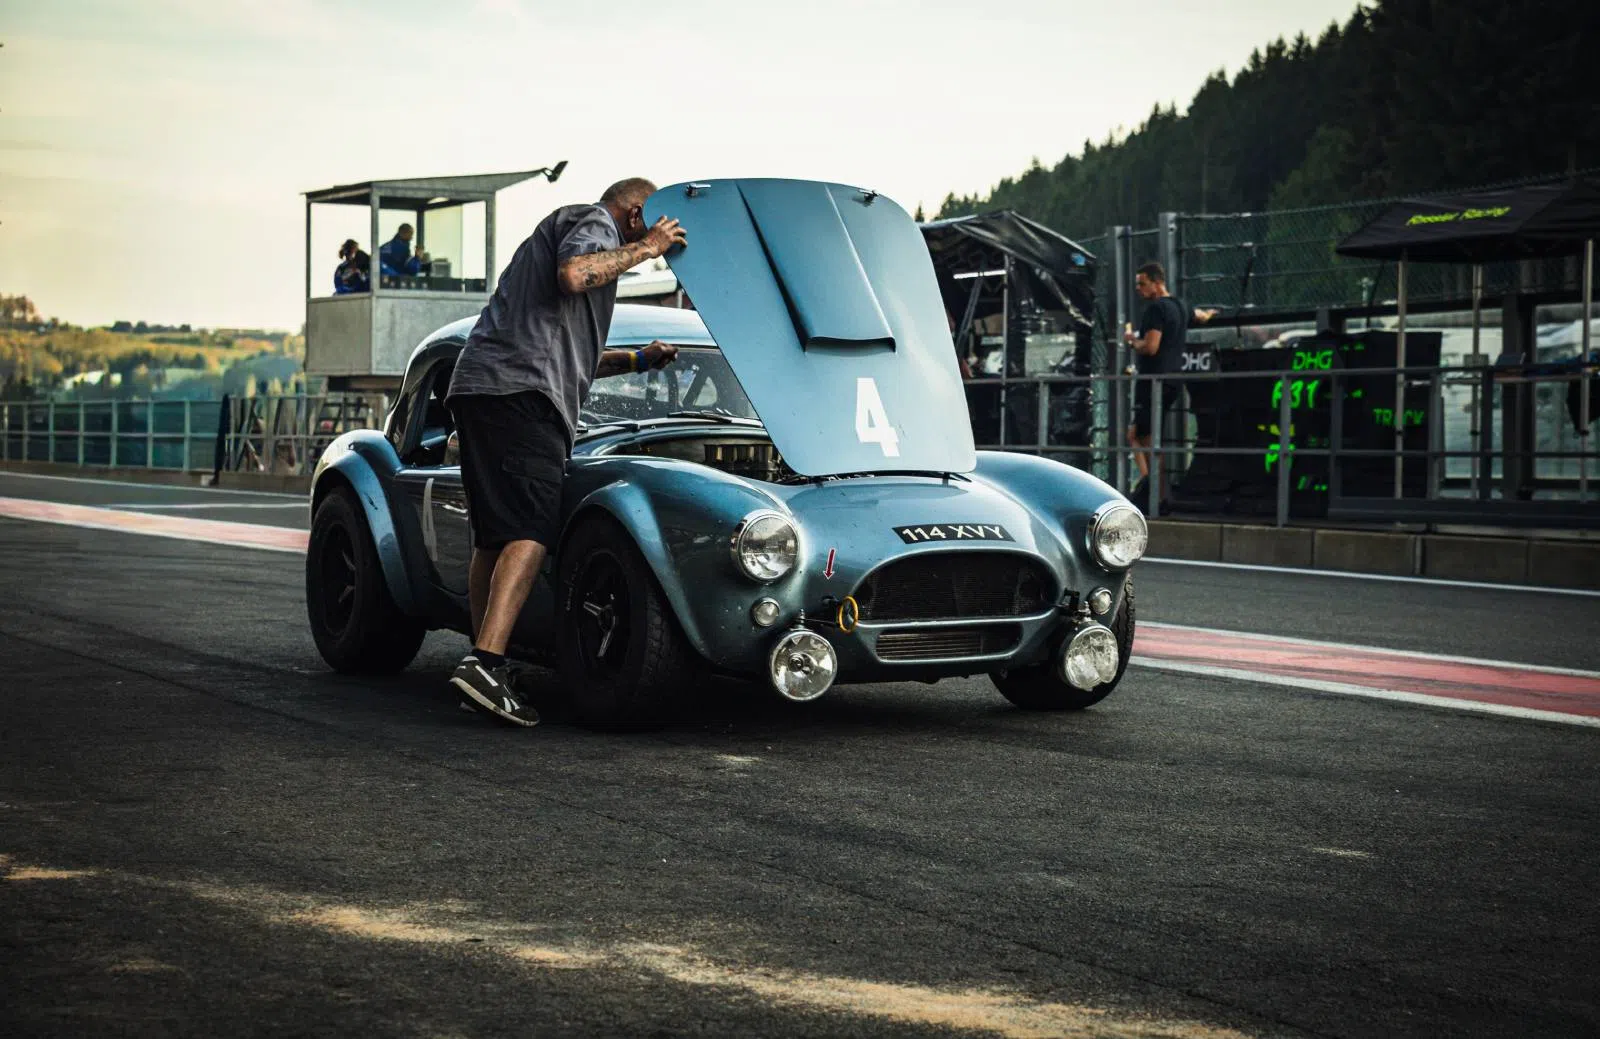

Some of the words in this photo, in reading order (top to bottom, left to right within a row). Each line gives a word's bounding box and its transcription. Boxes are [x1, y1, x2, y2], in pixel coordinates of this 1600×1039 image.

[1292, 351, 1333, 371] DHG
[855, 377, 900, 457] 4
[902, 526, 947, 541] 114
[947, 525, 1004, 539] XVY
